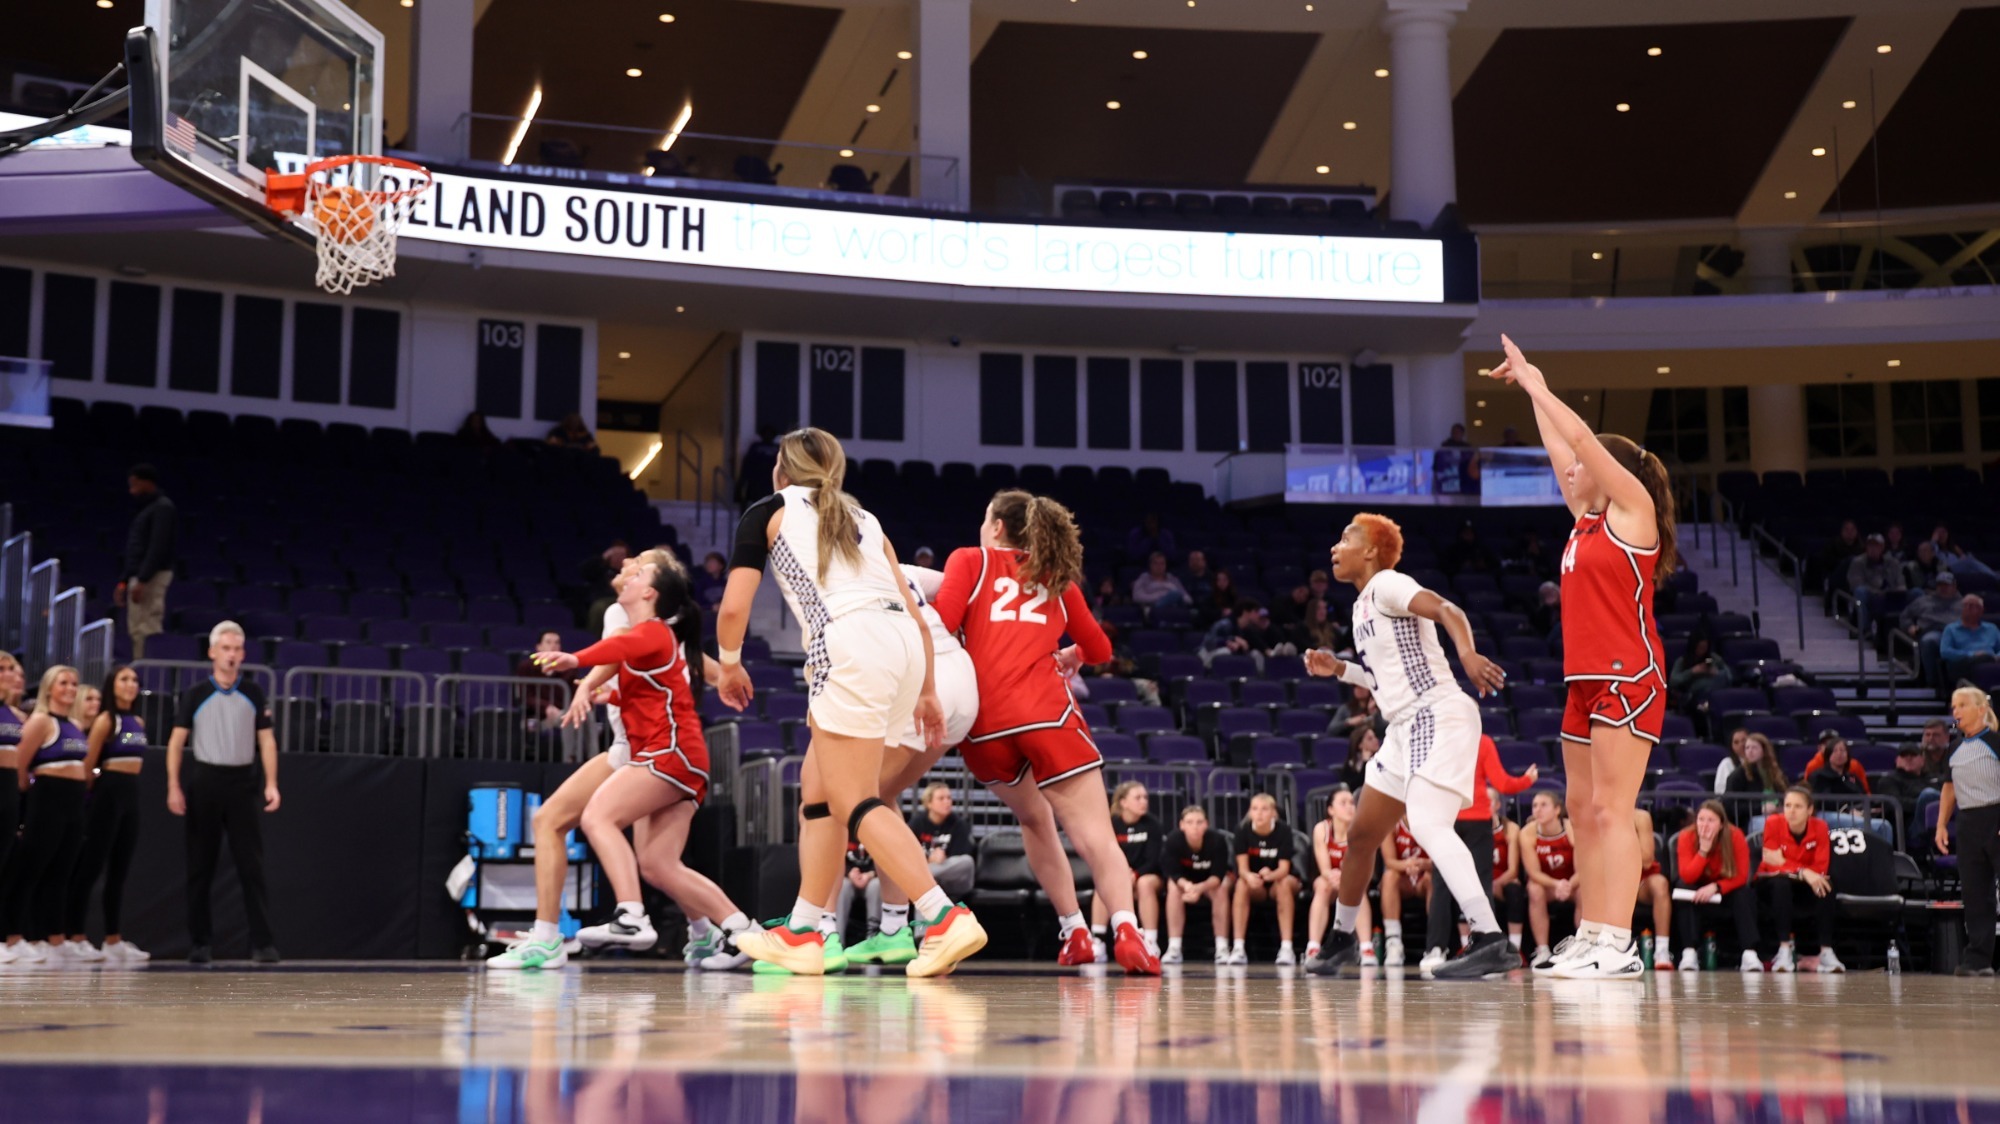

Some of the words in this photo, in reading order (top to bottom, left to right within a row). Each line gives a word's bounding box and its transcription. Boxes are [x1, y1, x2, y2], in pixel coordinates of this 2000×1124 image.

[565, 195, 704, 252] SOUTH
[731, 203, 811, 256] the
[833, 218, 1009, 271] world's
[1033, 224, 1198, 286] largest
[1223, 232, 1421, 286] furniture
[482, 323, 523, 348] 103
[814, 348, 853, 371] 102
[1302, 366, 1341, 388] 102
[990, 576, 1048, 625] 22
[1358, 649, 1379, 691] 5
[1830, 829, 1867, 855] 33
[1546, 854, 1564, 870] 12
